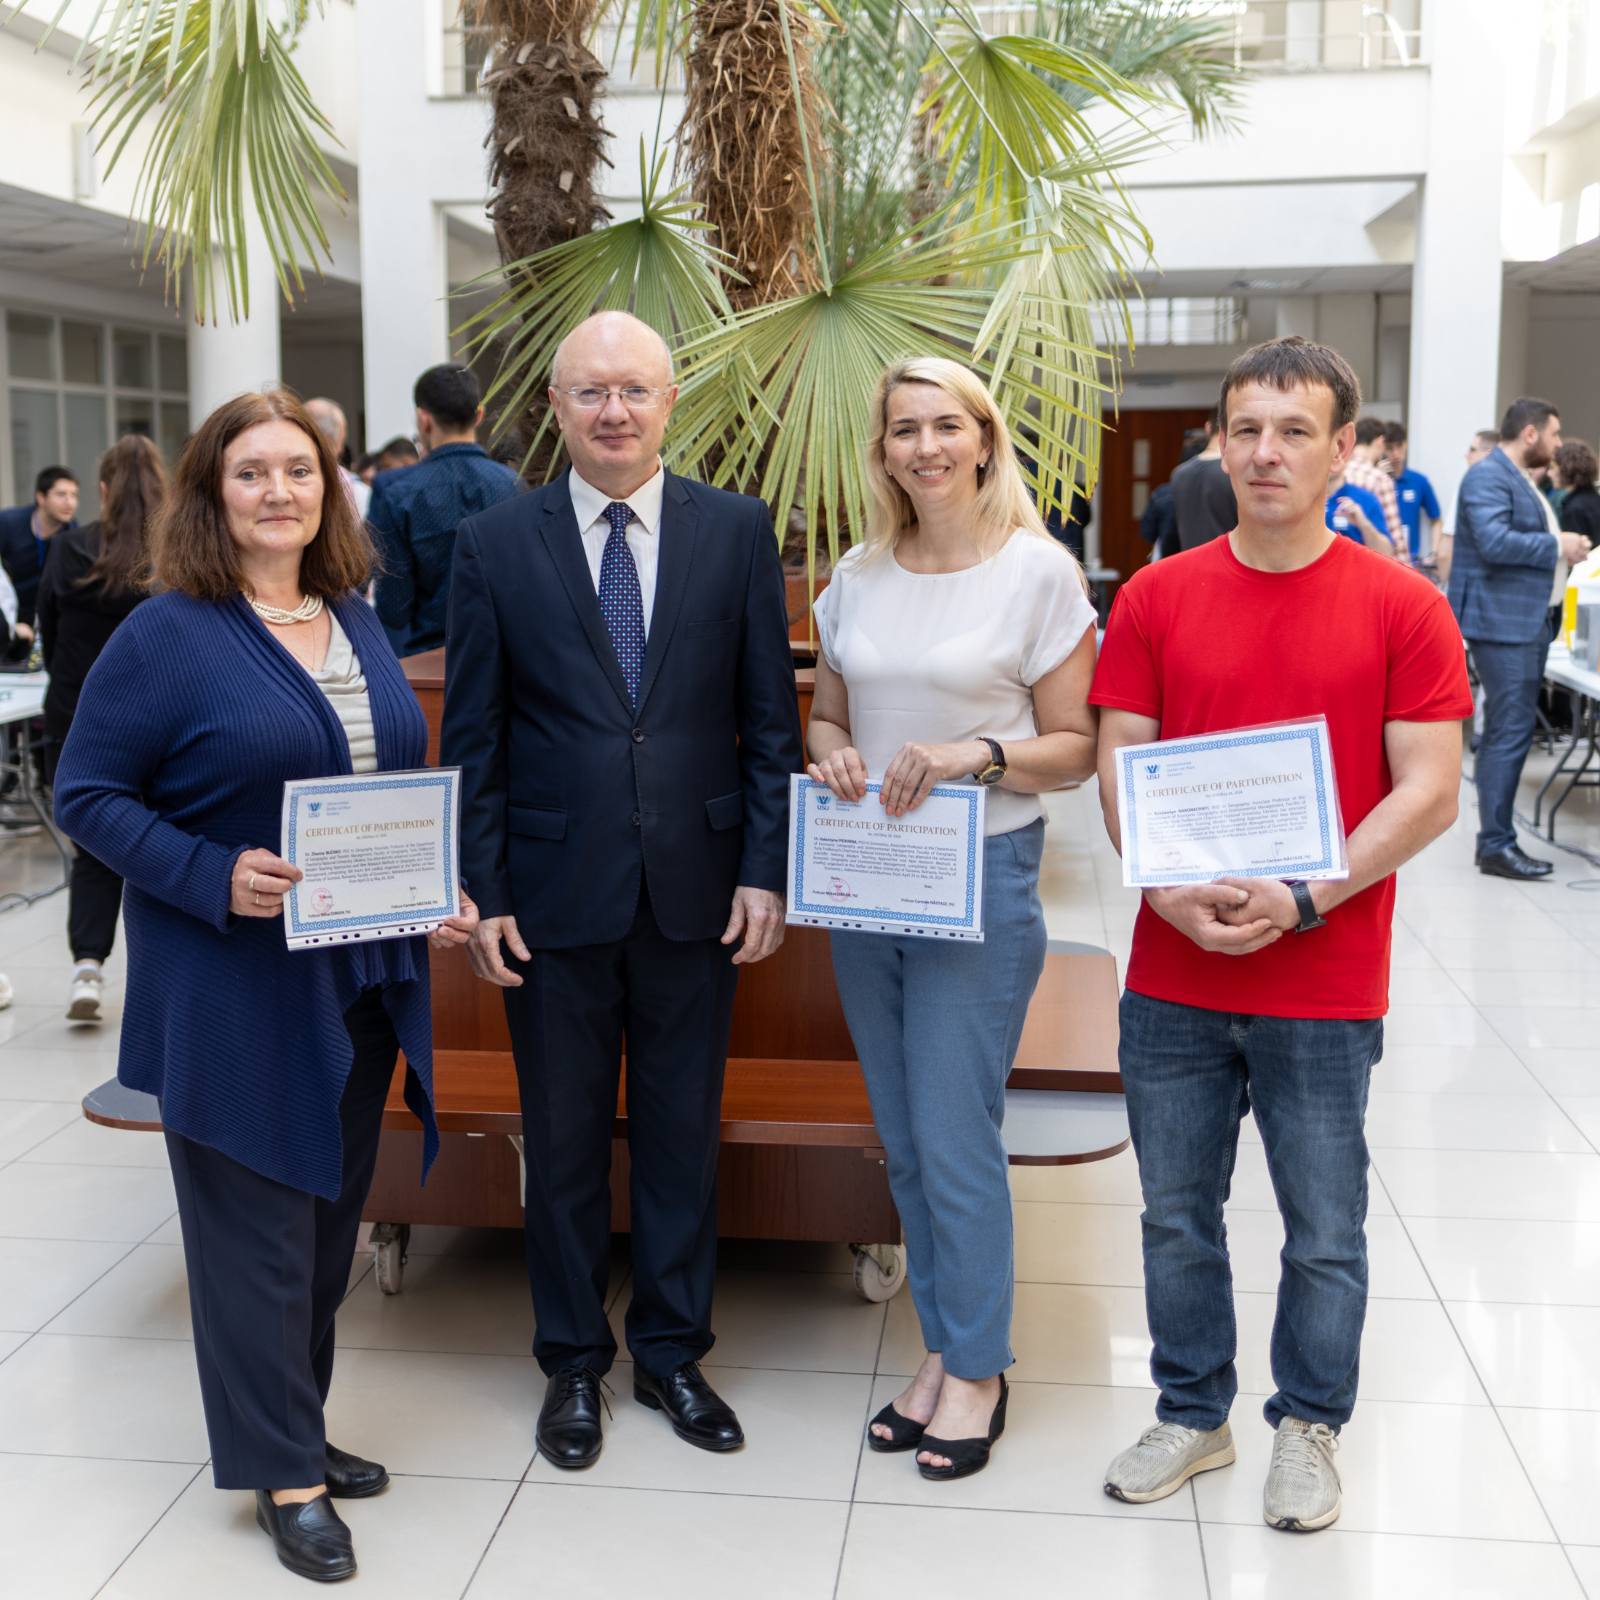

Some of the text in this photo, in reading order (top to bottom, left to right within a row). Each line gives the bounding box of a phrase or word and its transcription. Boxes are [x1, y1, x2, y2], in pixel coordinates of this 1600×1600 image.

[1146, 783, 1208, 798] CERTIFICATE
[1210, 782, 1224, 791] OF
[1226, 772, 1303, 789] PARTICIPATION
[305, 824, 359, 838] CERTIFICATE
[361, 824, 371, 833] OF
[373, 818, 435, 831] PARTICIPATION
[814, 817, 957, 836] CERTIFICATE OF PARTICIPATION
